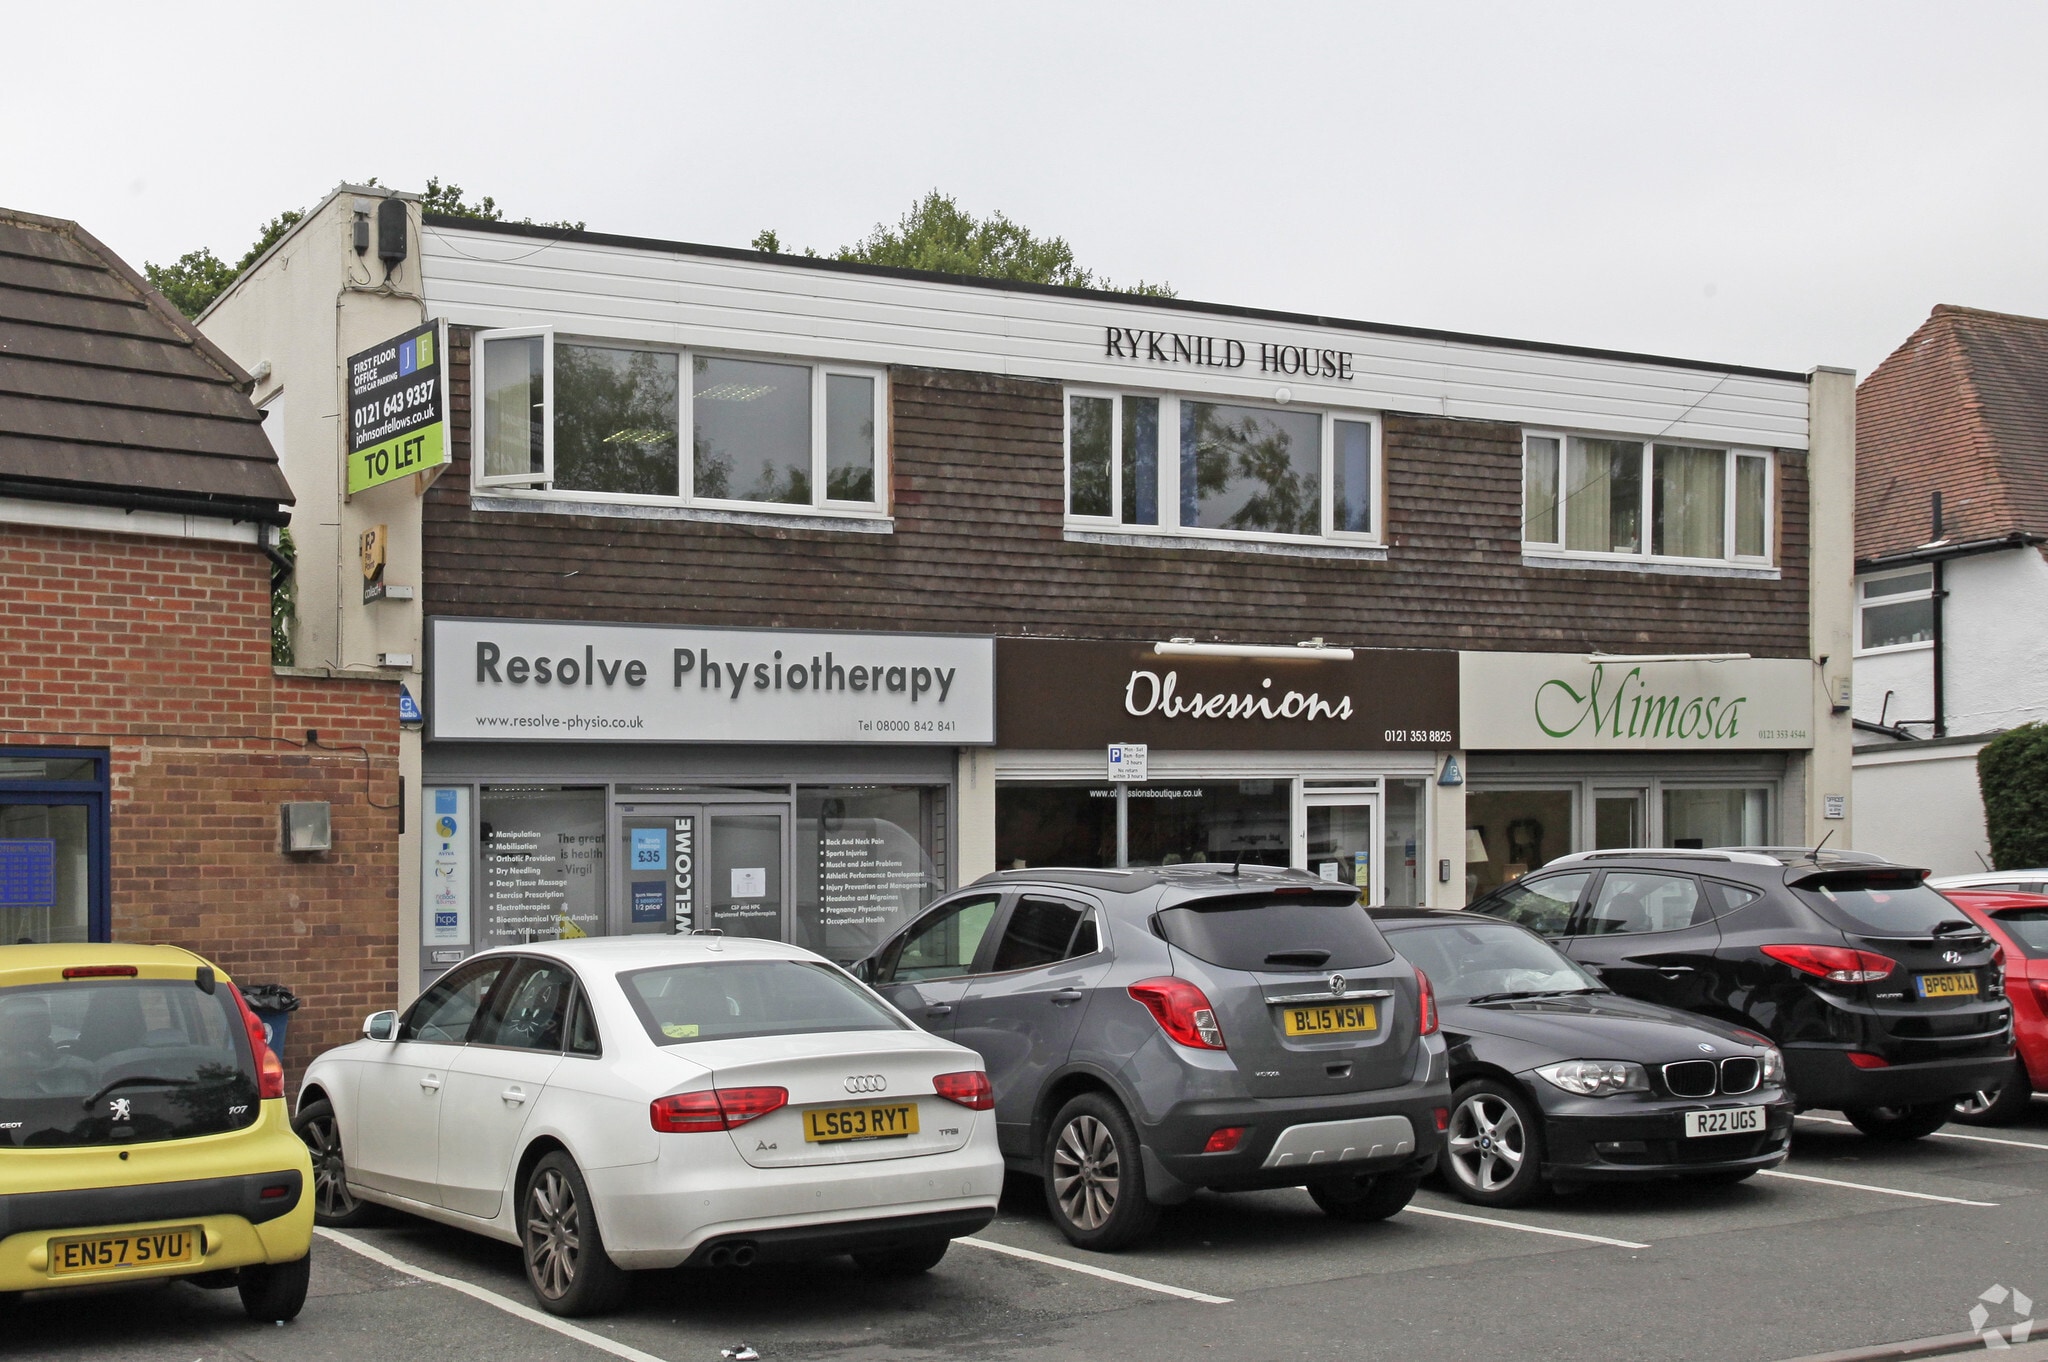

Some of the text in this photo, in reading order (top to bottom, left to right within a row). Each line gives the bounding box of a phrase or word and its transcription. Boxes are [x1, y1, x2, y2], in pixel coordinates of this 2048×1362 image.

[405, 340, 427, 369] J F
[1105, 327, 1354, 380] RYKNILD HOUSE
[354, 348, 396, 375] FIRST FLOOR
[354, 368, 378, 387] OFFICE
[354, 371, 398, 396] WITH CAR PARKING
[354, 379, 434, 428] 0121 643 9337
[356, 403, 434, 448] johnsonfellows.co.uk
[364, 435, 425, 479] TO LET
[476, 641, 956, 702] Resolve Physiotherapy
[1125, 670, 1353, 721] Obsessions
[1534, 663, 1746, 740] Mimosa
[476, 714, 644, 731] www.resolve-physio.co.uk
[858, 720, 956, 732] Tel 08000 842 841
[1384, 730, 1452, 742] 0121 353 8825
[1758, 730, 1806, 739] 0121 353 4544
[1112, 750, 1120, 762] P
[1089, 788, 1203, 799] www.obssionsboutique.co.uk
[496, 831, 541, 839] Manipulation
[557, 834, 575, 843] The
[560, 849, 602, 859] is health
[638, 851, 660, 862] £35
[826, 849, 868, 858] Sports Injuries
[510, 867, 541, 875] Needling
[565, 864, 592, 876] Virgil
[675, 819, 692, 935] WELCOME
[496, 880, 514, 888] Deep
[890, 882, 927, 890] Management
[524, 891, 564, 899] Prescription
[870, 894, 898, 902] Migraines
[496, 903, 550, 911] Electrotherapies
[436, 914, 456, 925] hcpc
[571, 914, 598, 922] Analysis
[1924, 976, 1954, 994] BP60
[1957, 975, 1977, 991] XAA
[1295, 1007, 1365, 1031] BL15 WSW
[228, 1105, 248, 1115] 107
[812, 1107, 909, 1137] LS63 RYT
[1698, 1110, 1756, 1133] R22 UGS
[755, 1140, 777, 1151] A4
[64, 1233, 183, 1268] EN57 SVU
